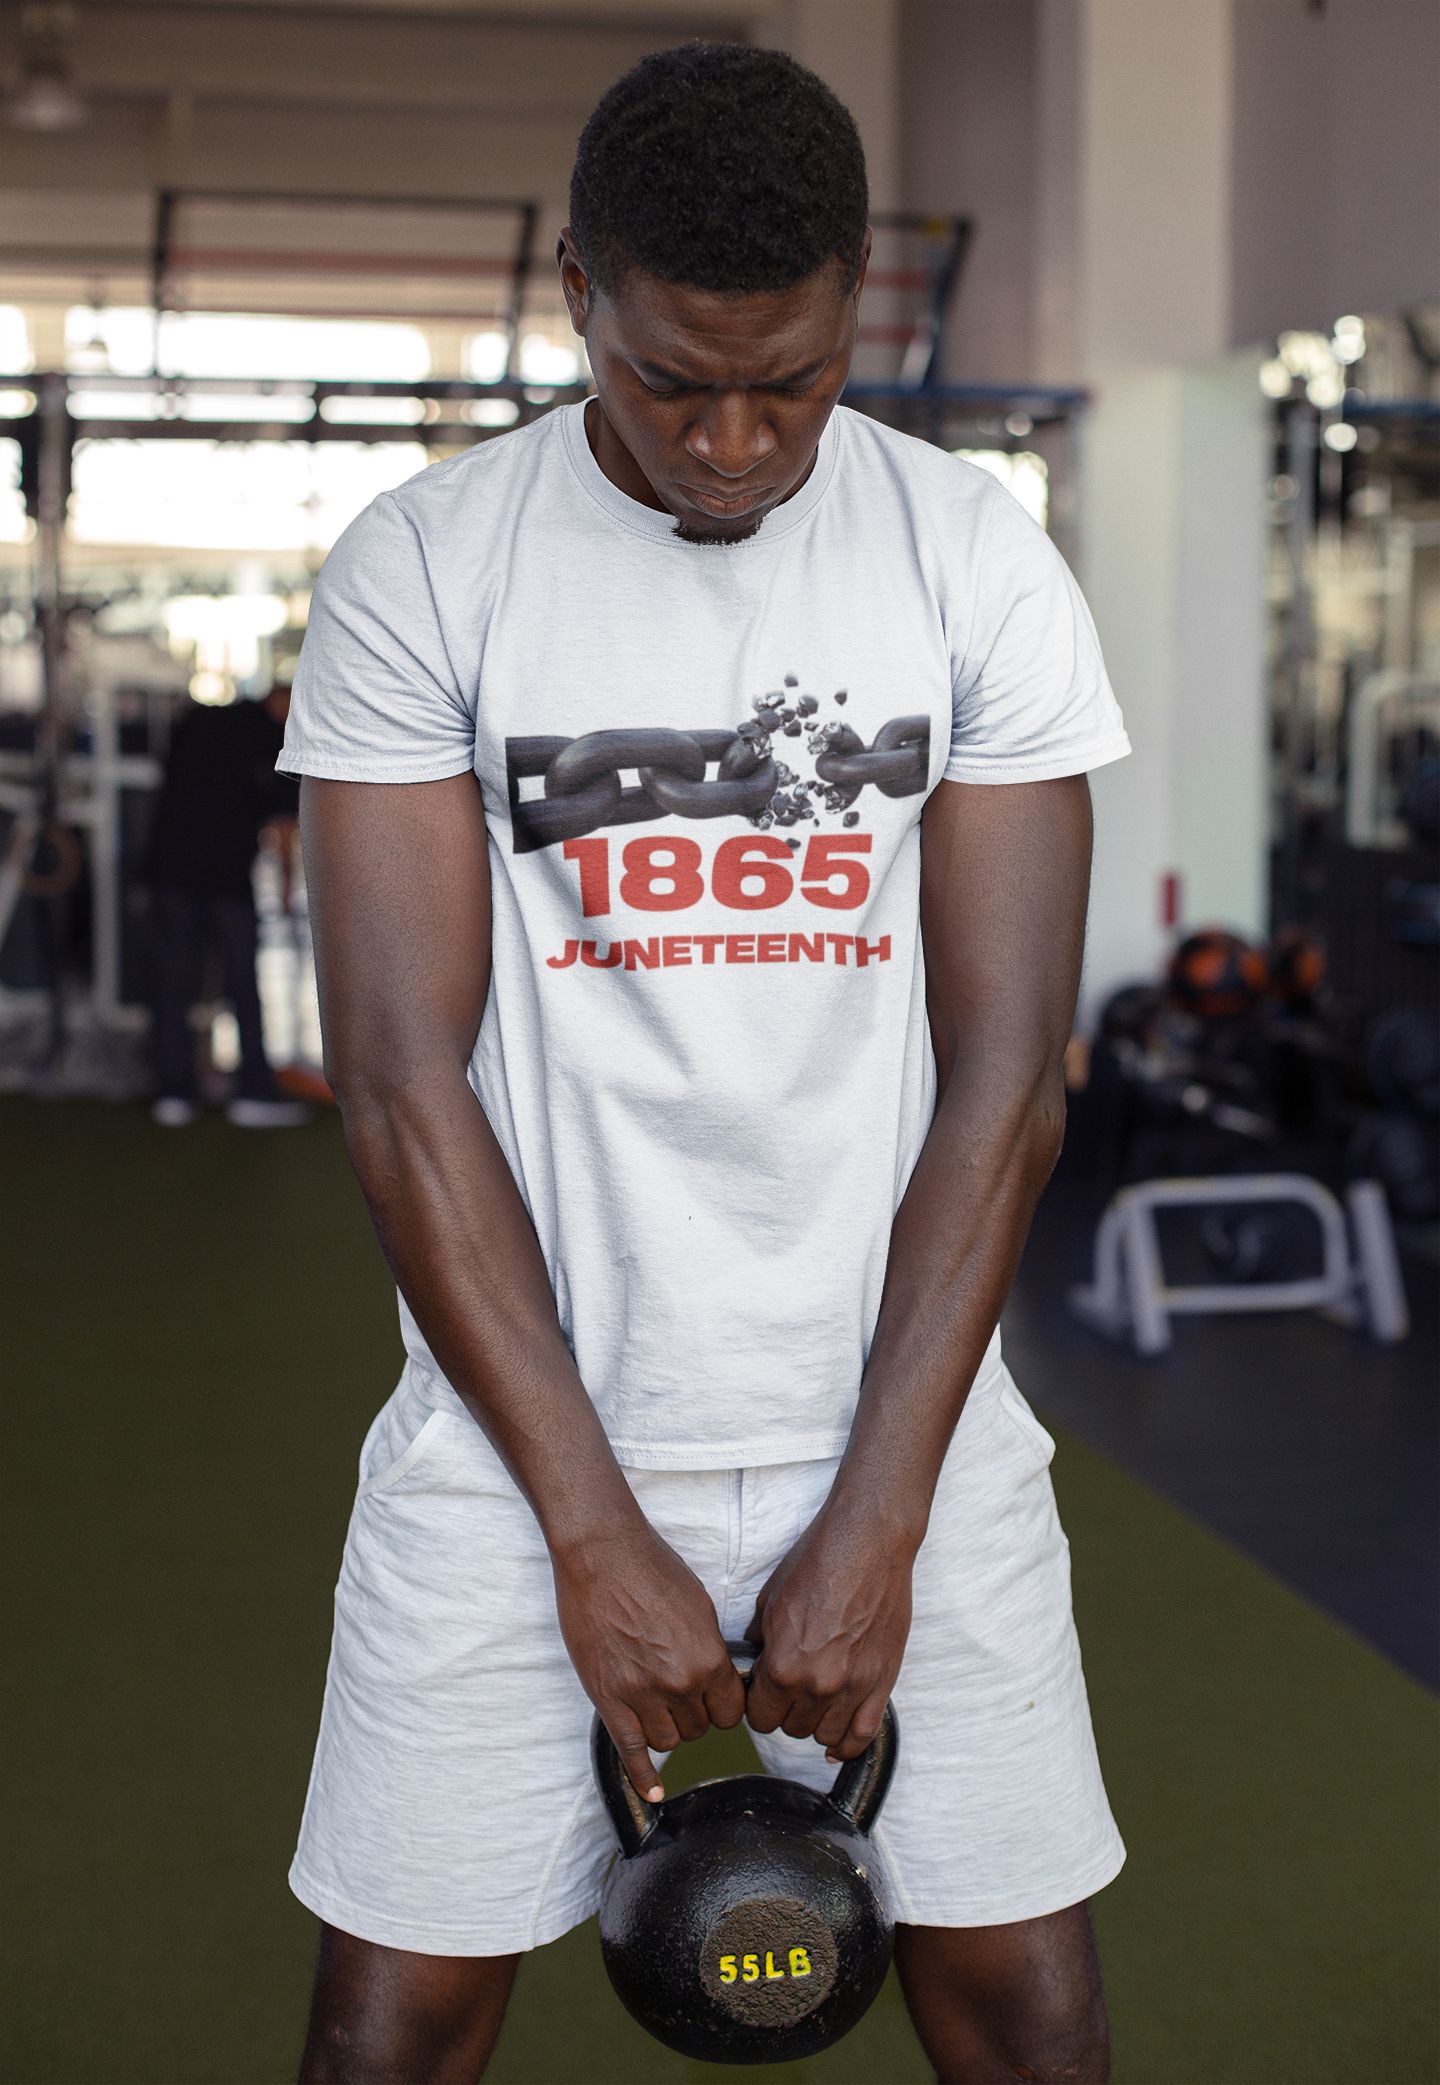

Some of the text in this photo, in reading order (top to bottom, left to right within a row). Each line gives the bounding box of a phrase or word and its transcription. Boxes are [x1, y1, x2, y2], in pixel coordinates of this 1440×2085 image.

[564, 835, 872, 917] 1865
[547, 934, 890, 970] JUNETEENTH
[720, 1948, 811, 1982] 55LB
